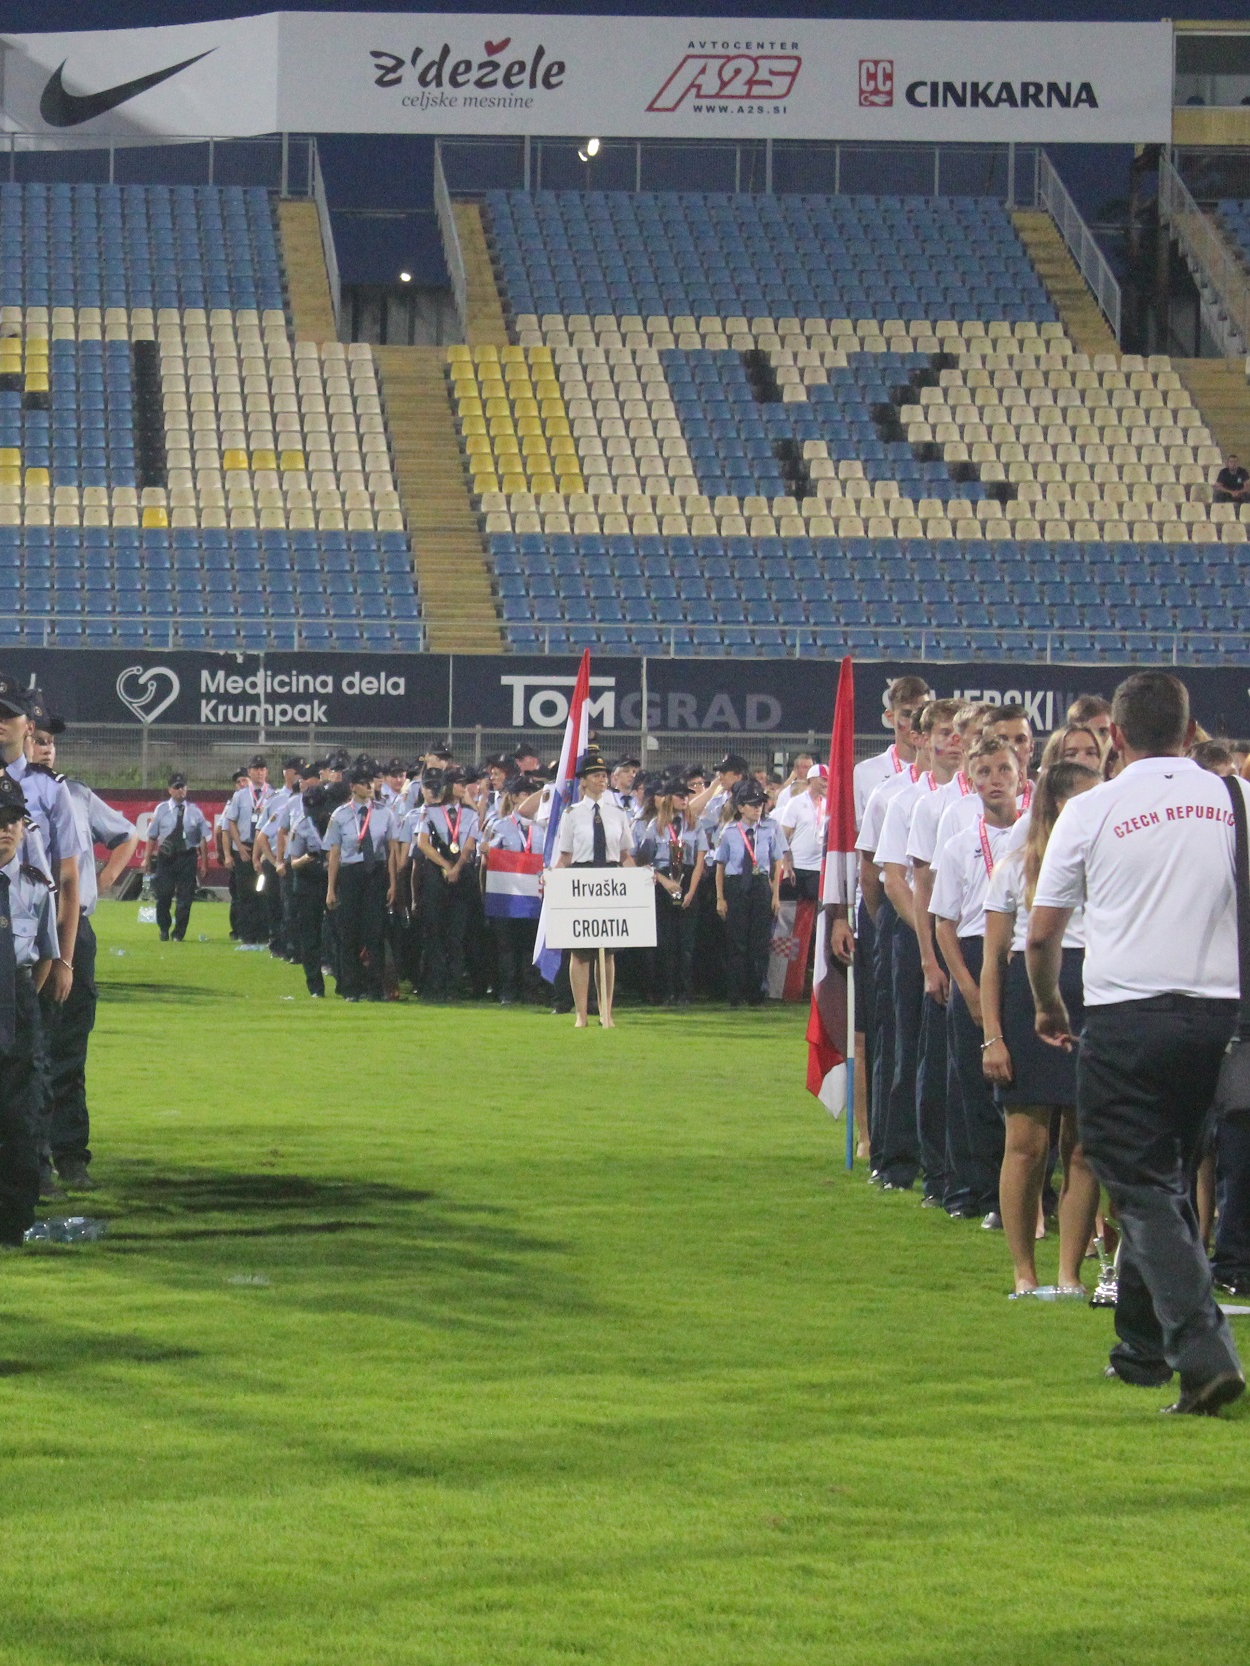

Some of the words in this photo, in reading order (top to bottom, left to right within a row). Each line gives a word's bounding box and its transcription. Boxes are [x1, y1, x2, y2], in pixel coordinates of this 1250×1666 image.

[687, 40, 800, 51] AVTOCENTER
[401, 92, 457, 111] celjske
[463, 95, 534, 109] mesnine
[905, 80, 1099, 109] CINKARNA
[200, 670, 333, 695] Medicina
[341, 672, 405, 696] dela
[200, 700, 328, 727] Krumpak
[1113, 811, 1160, 839] CZECH
[1166, 805, 1236, 827] REPUBLIC
[572, 879, 627, 897] Hrvaška
[573, 919, 629, 937] CROATIA
